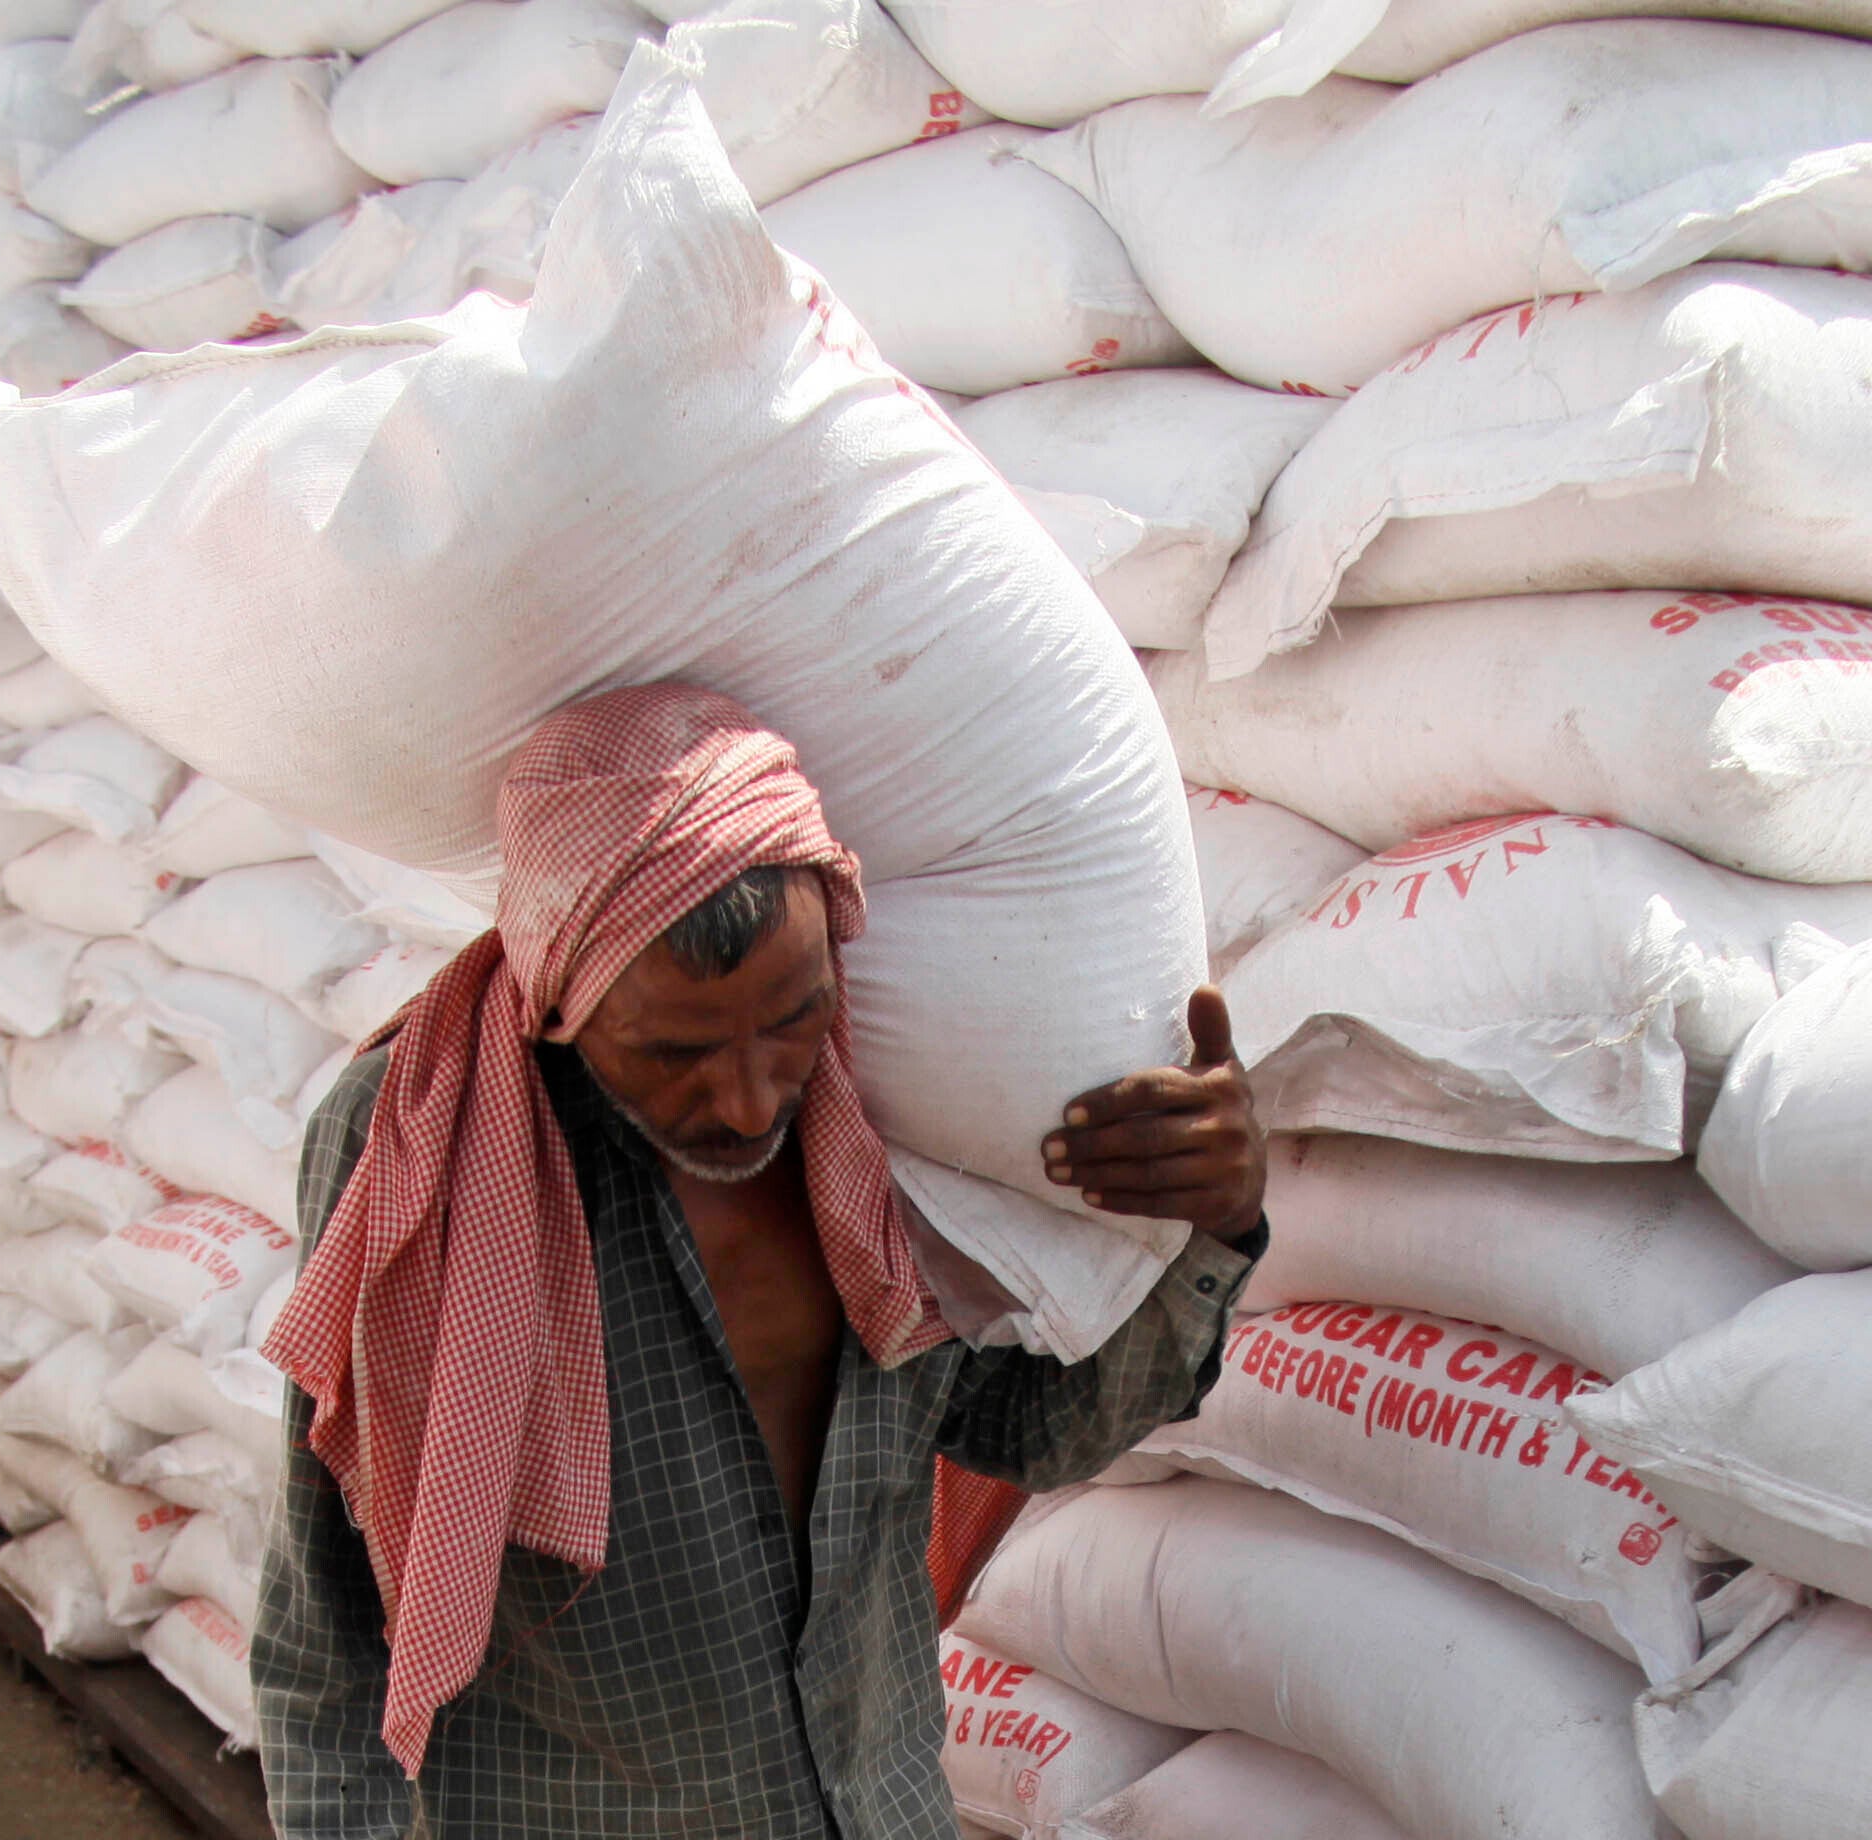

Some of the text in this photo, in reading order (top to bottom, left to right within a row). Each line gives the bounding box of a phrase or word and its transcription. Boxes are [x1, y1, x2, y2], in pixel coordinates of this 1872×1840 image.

[1272, 1302, 1445, 1370] SUGAR
[1241, 1330, 1369, 1416] BEFORE
[1364, 1374, 1520, 1459] (MONTH
[1518, 1418, 1559, 1468] &
[955, 1704, 1072, 1769] & YEAR)
